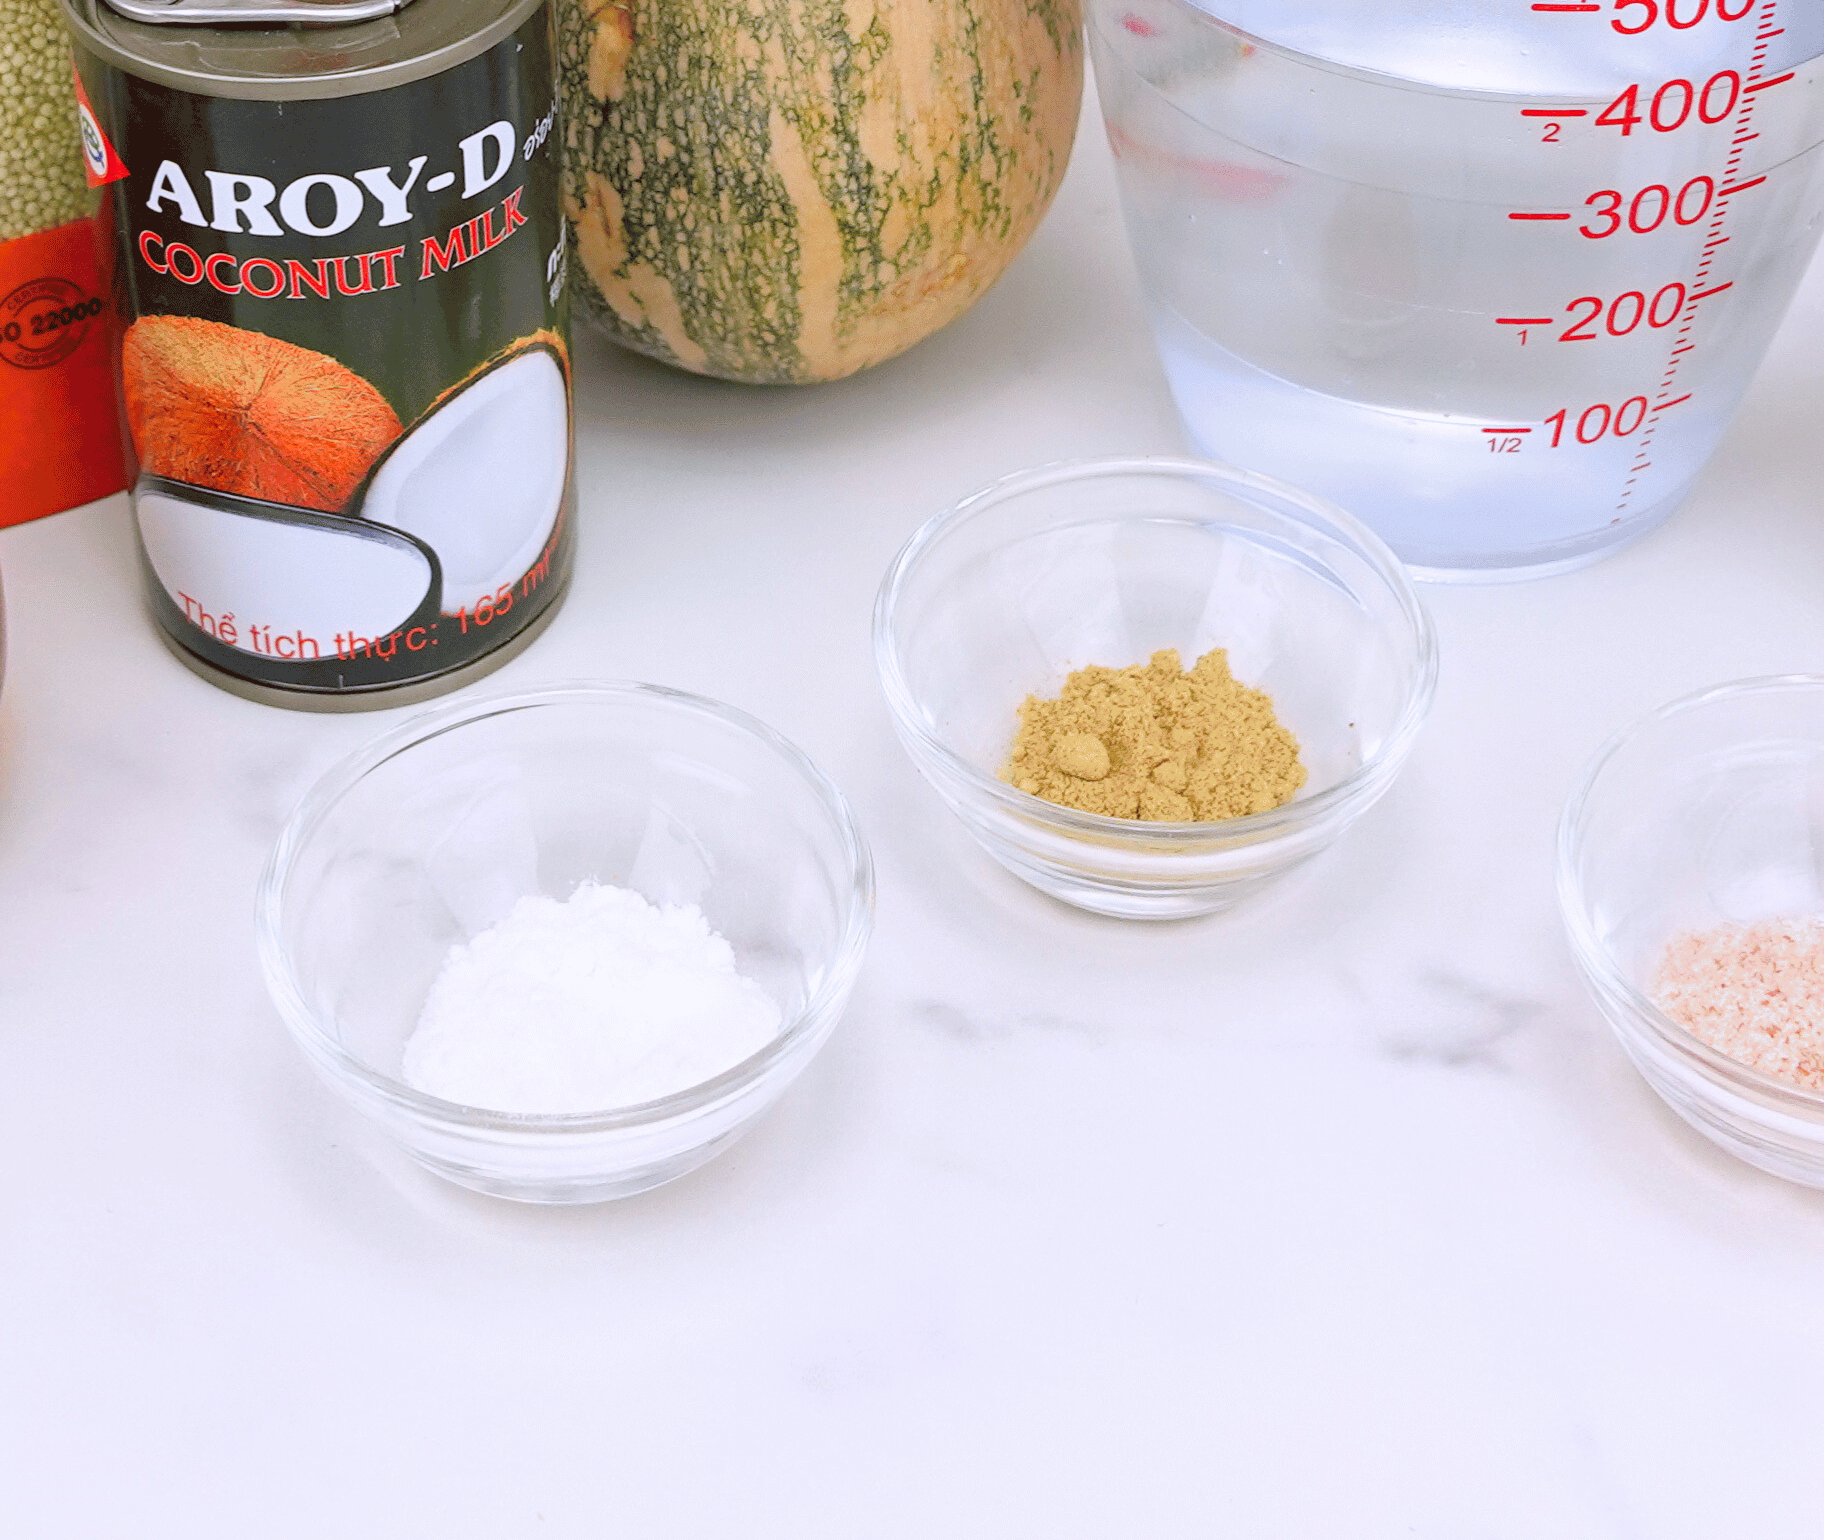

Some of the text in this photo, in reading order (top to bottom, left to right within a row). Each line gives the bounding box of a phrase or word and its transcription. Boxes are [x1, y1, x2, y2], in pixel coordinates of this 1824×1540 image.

[1541, 122, 1561, 143] 2
[1594, 68, 1742, 138] 400
[145, 119, 517, 238] AROY-D
[1579, 175, 1716, 240] 300
[138, 230, 407, 300] COCONUT
[418, 186, 530, 282] MILK
[30, 297, 103, 336] 22000
[1558, 282, 1689, 343] 200
[1486, 437, 1522, 454] 1/2
[1542, 395, 1650, 449] 100
[249, 623, 320, 661] tích
[333, 620, 440, 662] thực:
[454, 582, 514, 636] 165
